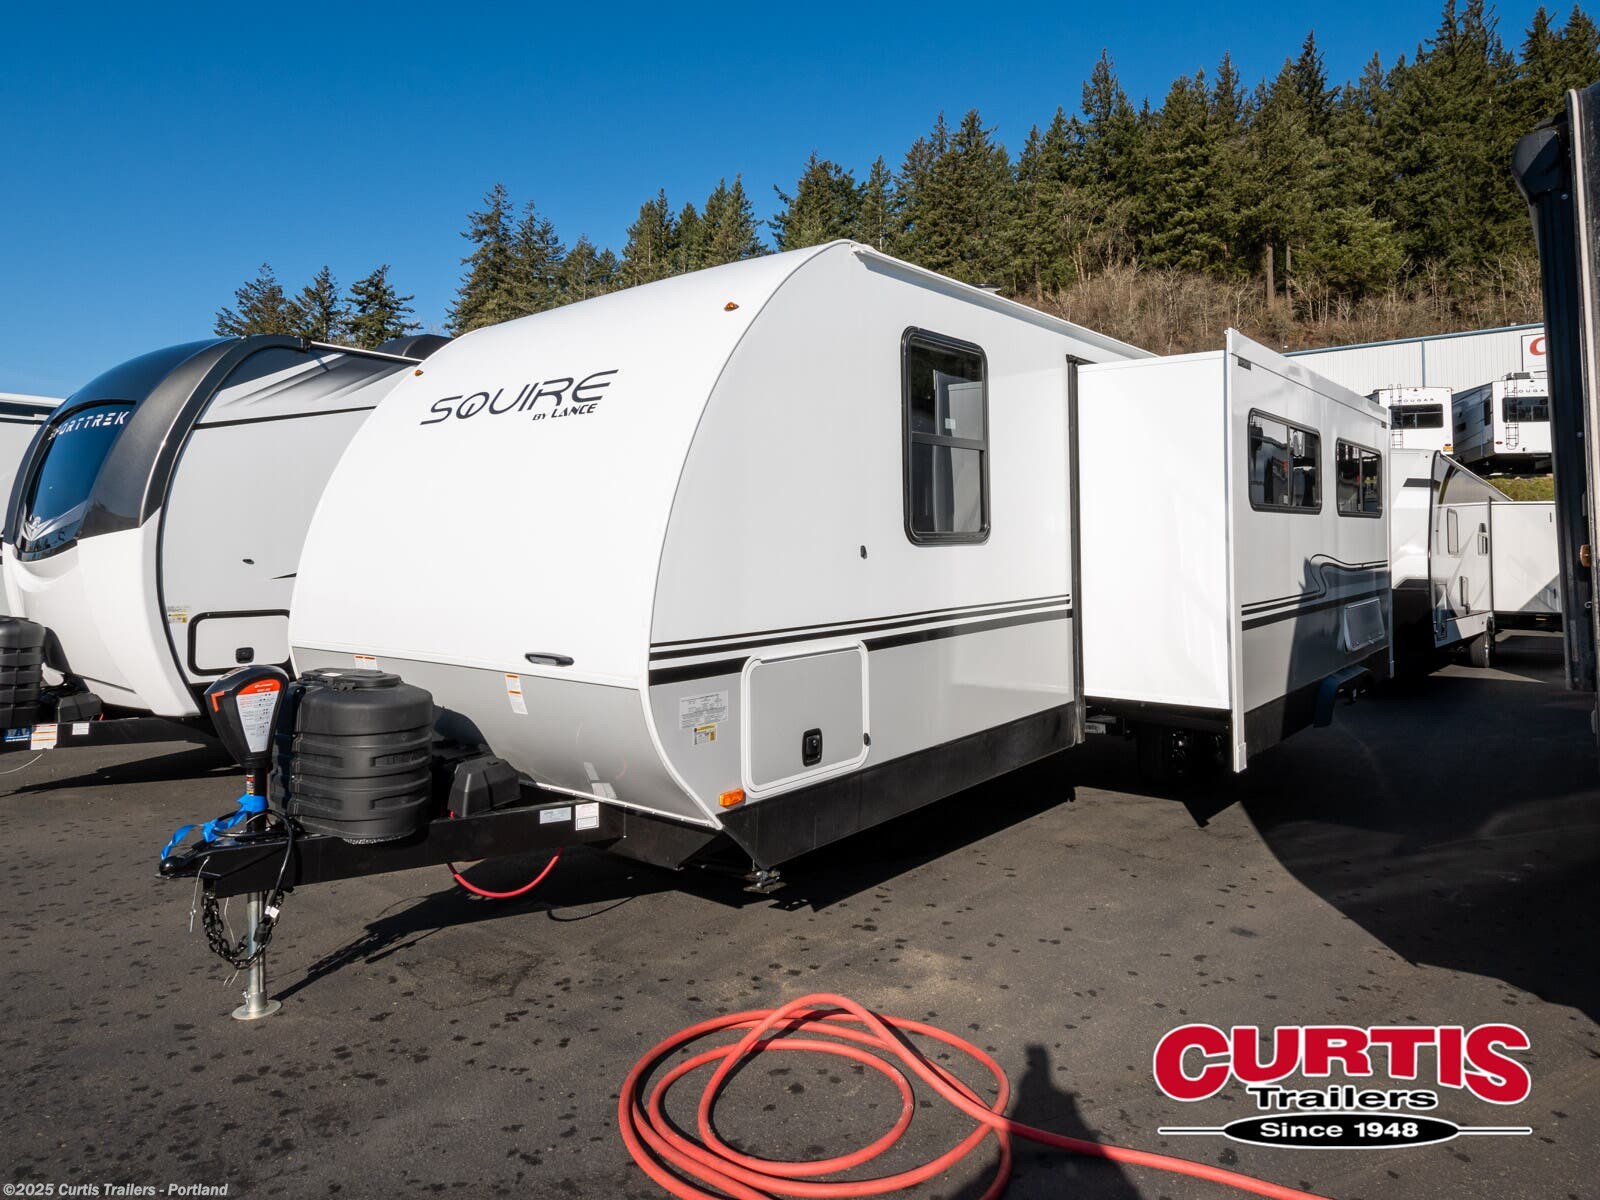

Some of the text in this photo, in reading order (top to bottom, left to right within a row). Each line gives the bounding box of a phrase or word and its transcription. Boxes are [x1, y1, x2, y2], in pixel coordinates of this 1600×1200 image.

[420, 369, 619, 425] SQUIRE
[532, 403, 598, 421] BY LANCE
